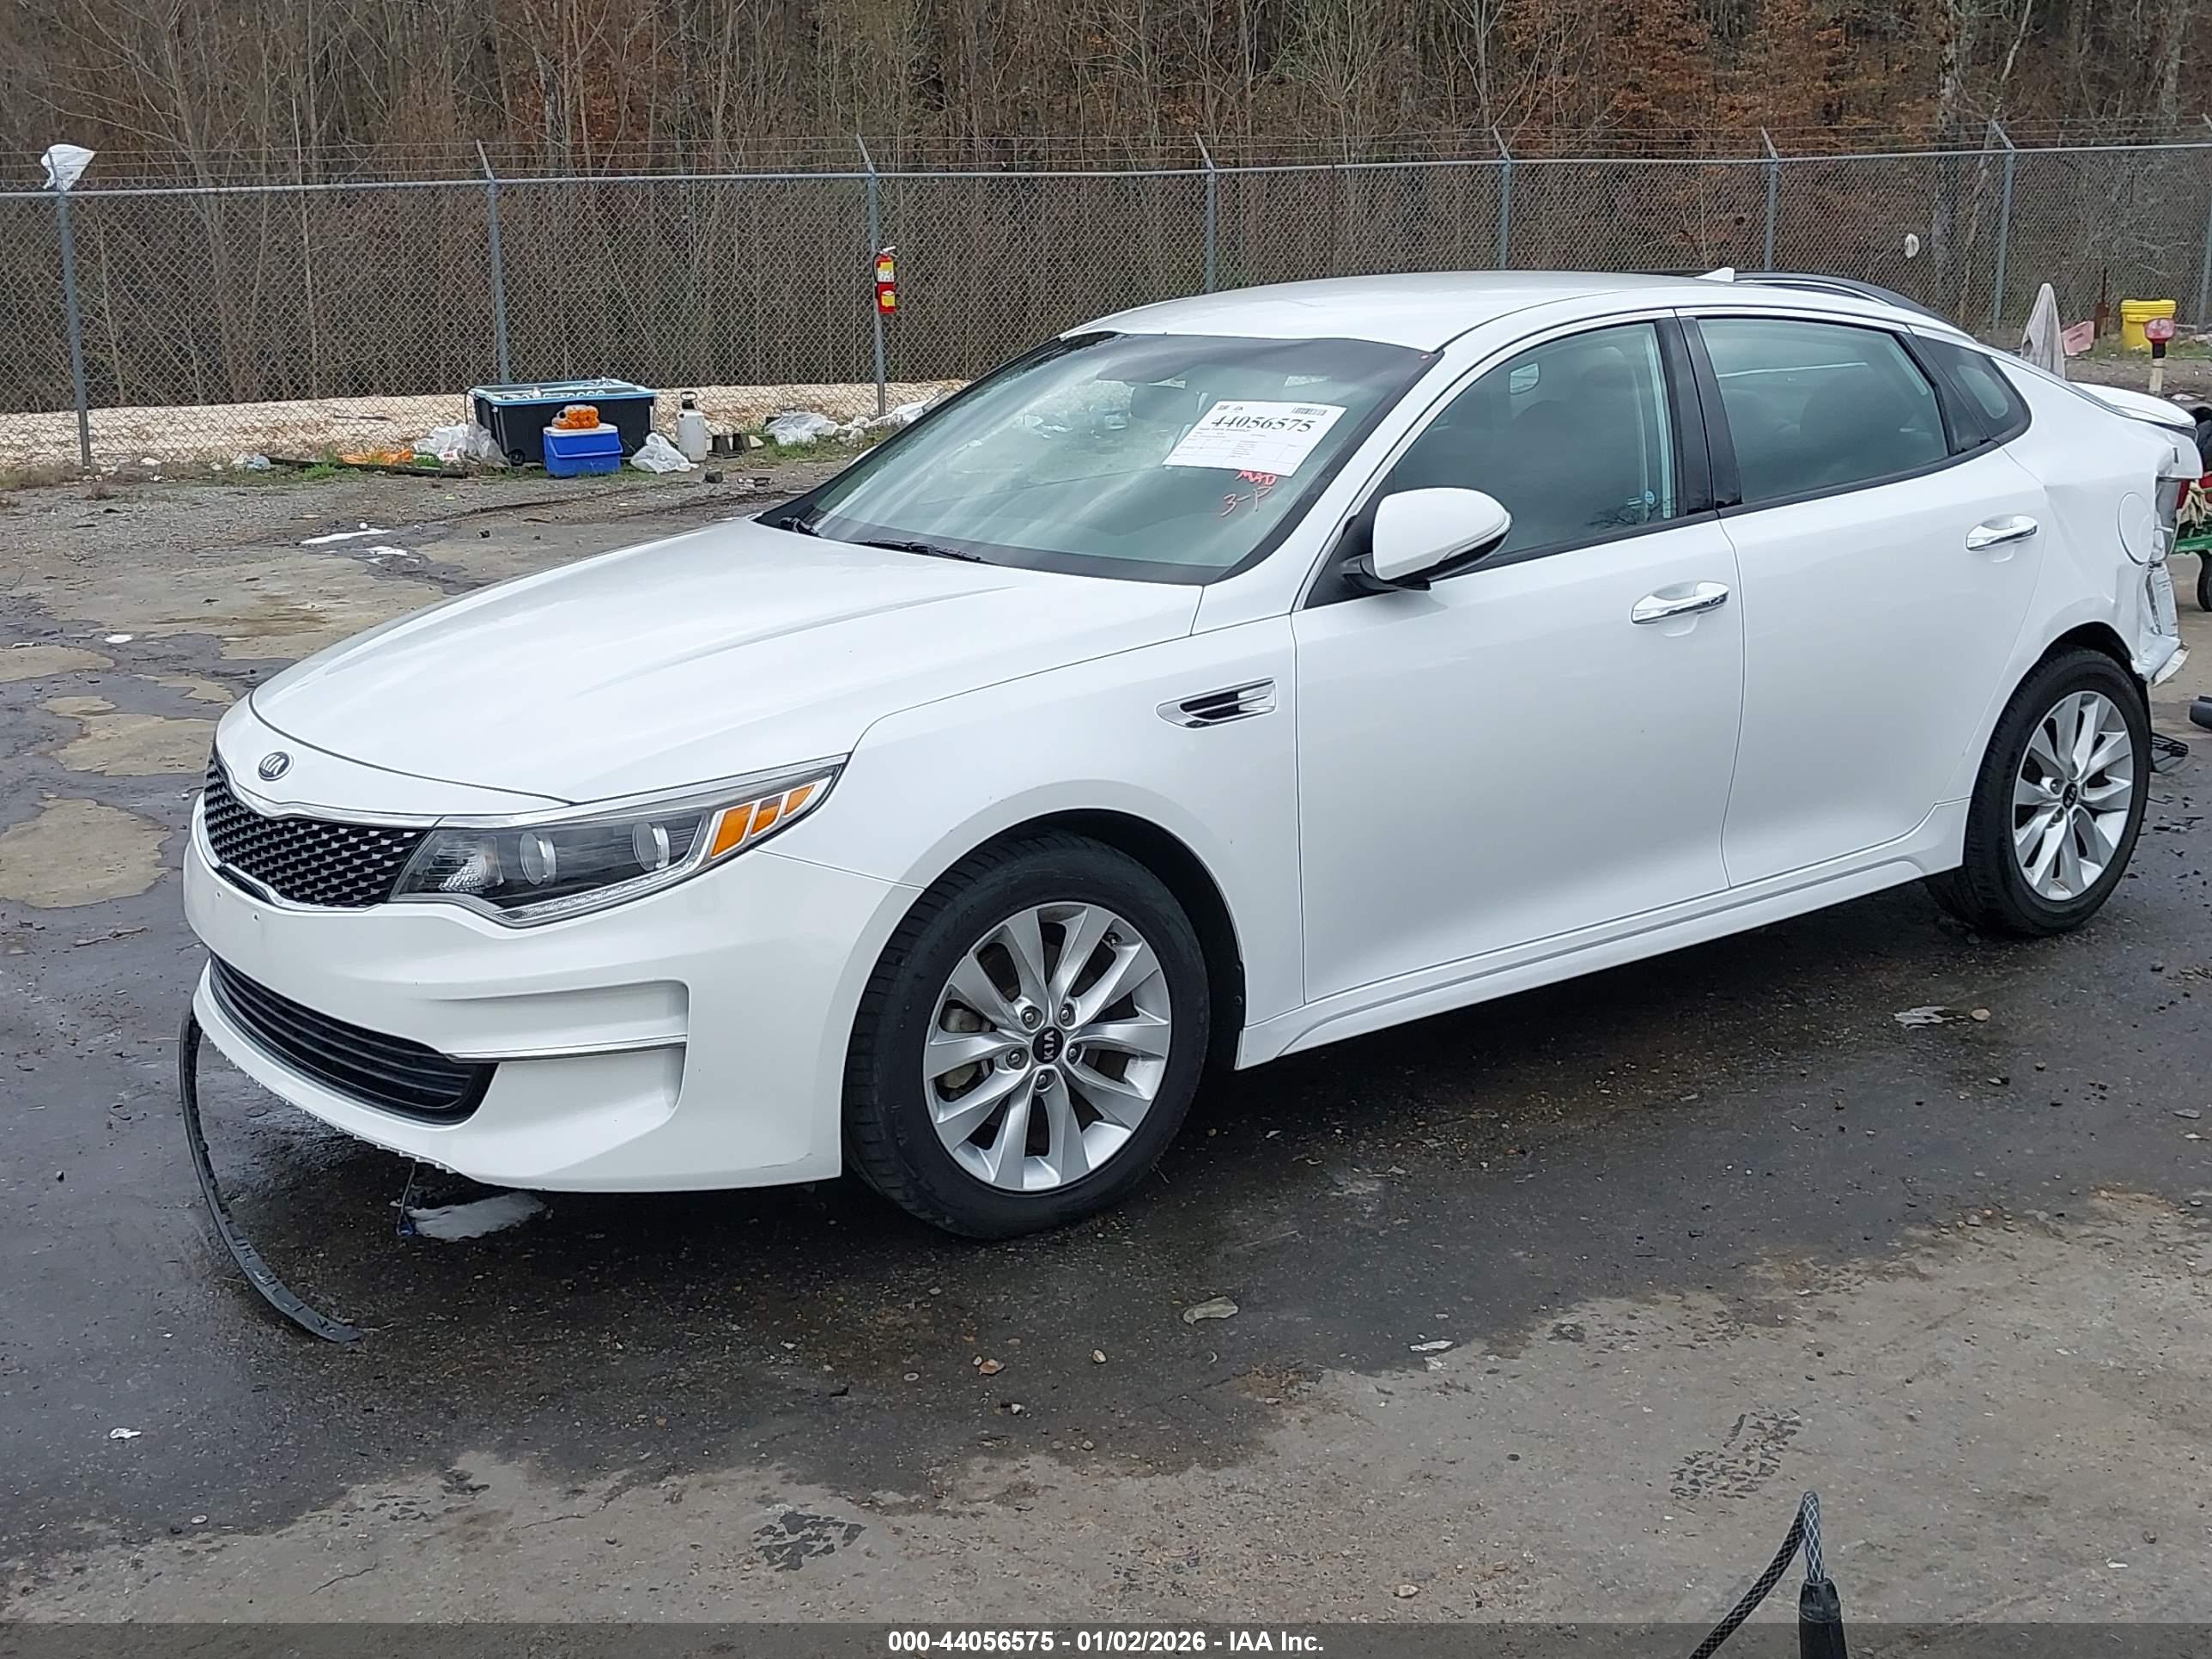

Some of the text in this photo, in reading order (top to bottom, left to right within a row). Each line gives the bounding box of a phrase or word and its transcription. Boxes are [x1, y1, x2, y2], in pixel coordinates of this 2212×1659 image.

[1211, 415, 1316, 433] 44056575
[260, 754, 286, 775] KIA
[1043, 1030, 1055, 1060] KIA
